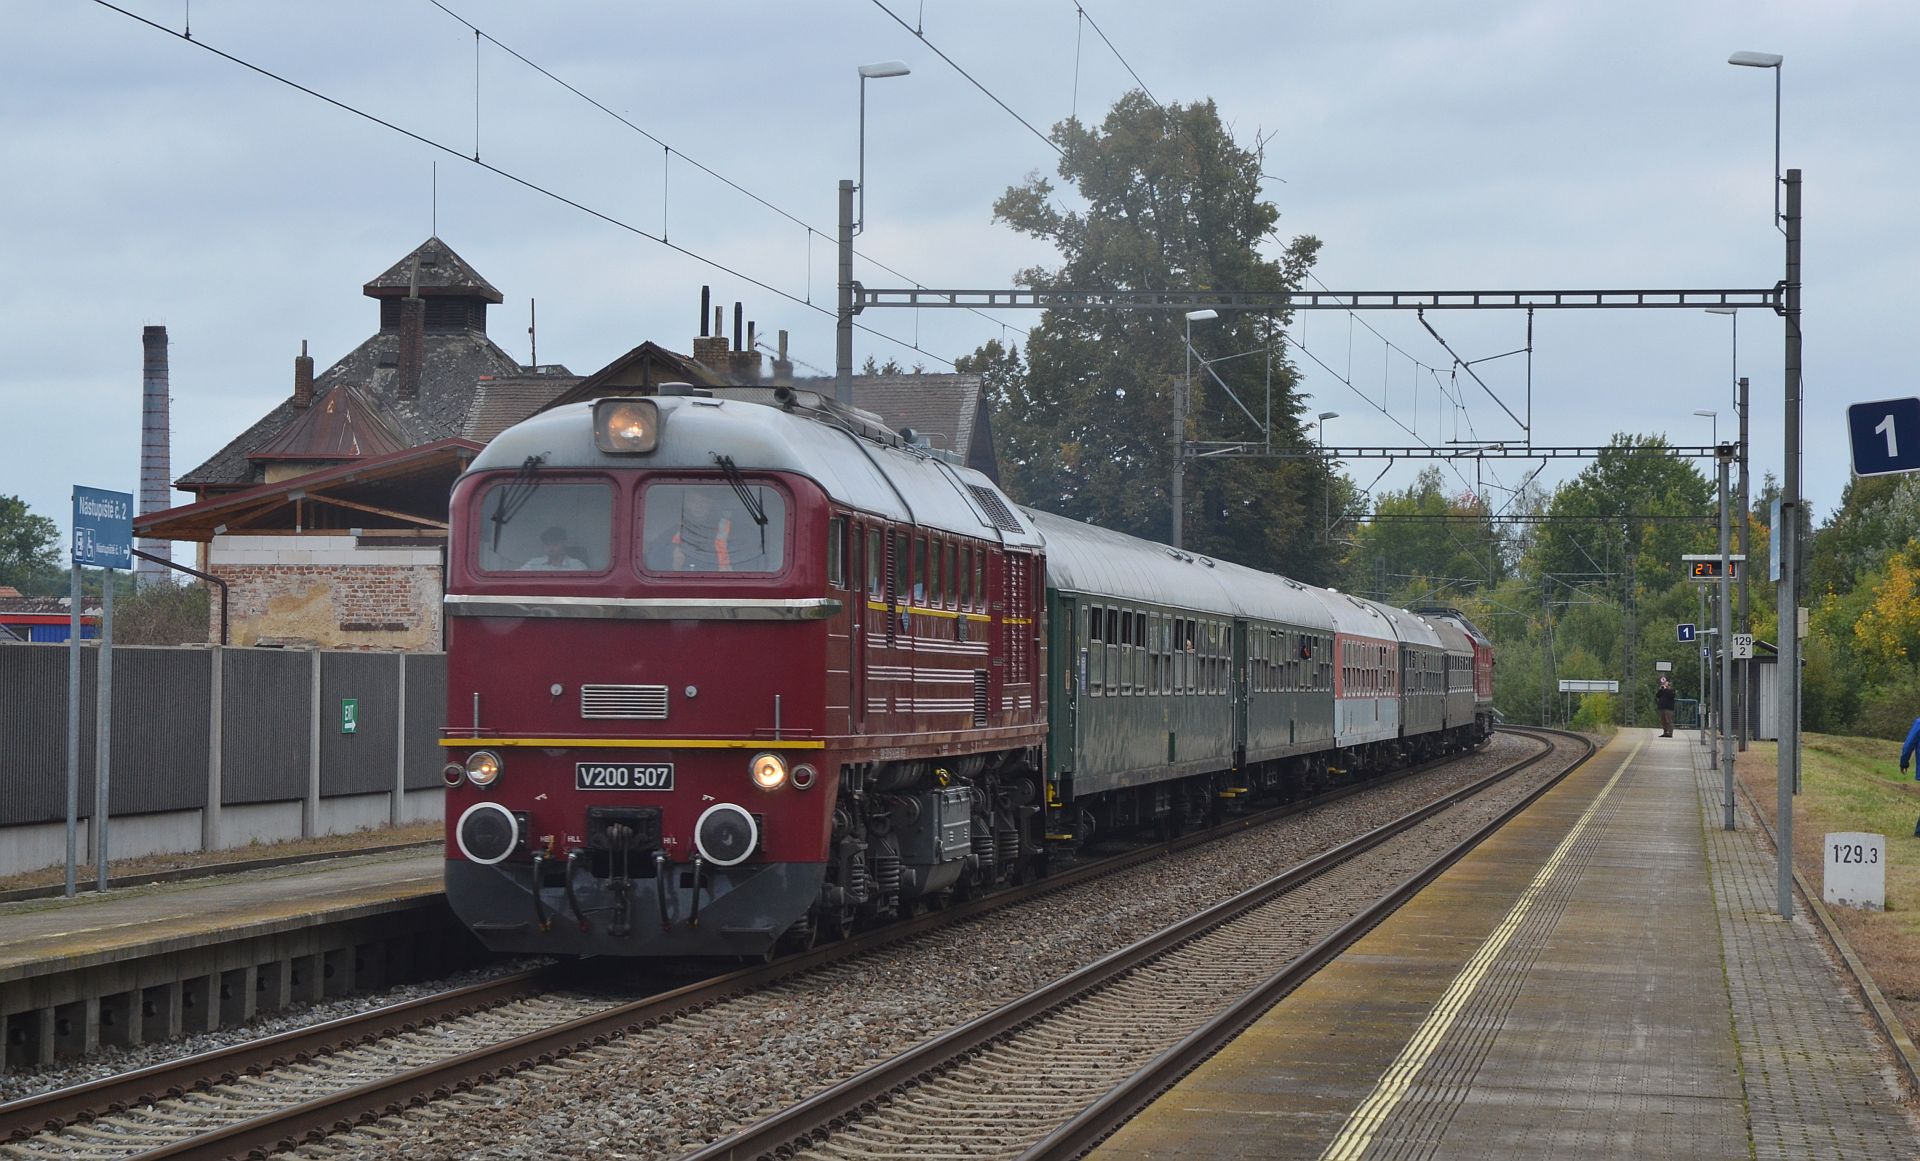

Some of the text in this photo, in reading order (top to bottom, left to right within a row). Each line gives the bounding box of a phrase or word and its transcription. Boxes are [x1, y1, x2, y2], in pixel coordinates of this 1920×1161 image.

[1875, 414, 1898, 457] 1
[79, 496, 114, 521] Nástupiště
[122, 502, 127, 520] 2
[1683, 627, 1689, 639] 1
[1734, 636, 1752, 646] 129
[1740, 647, 1746, 656] 2
[580, 767, 669, 787] V200 507
[1833, 844, 1878, 864] 129.3
